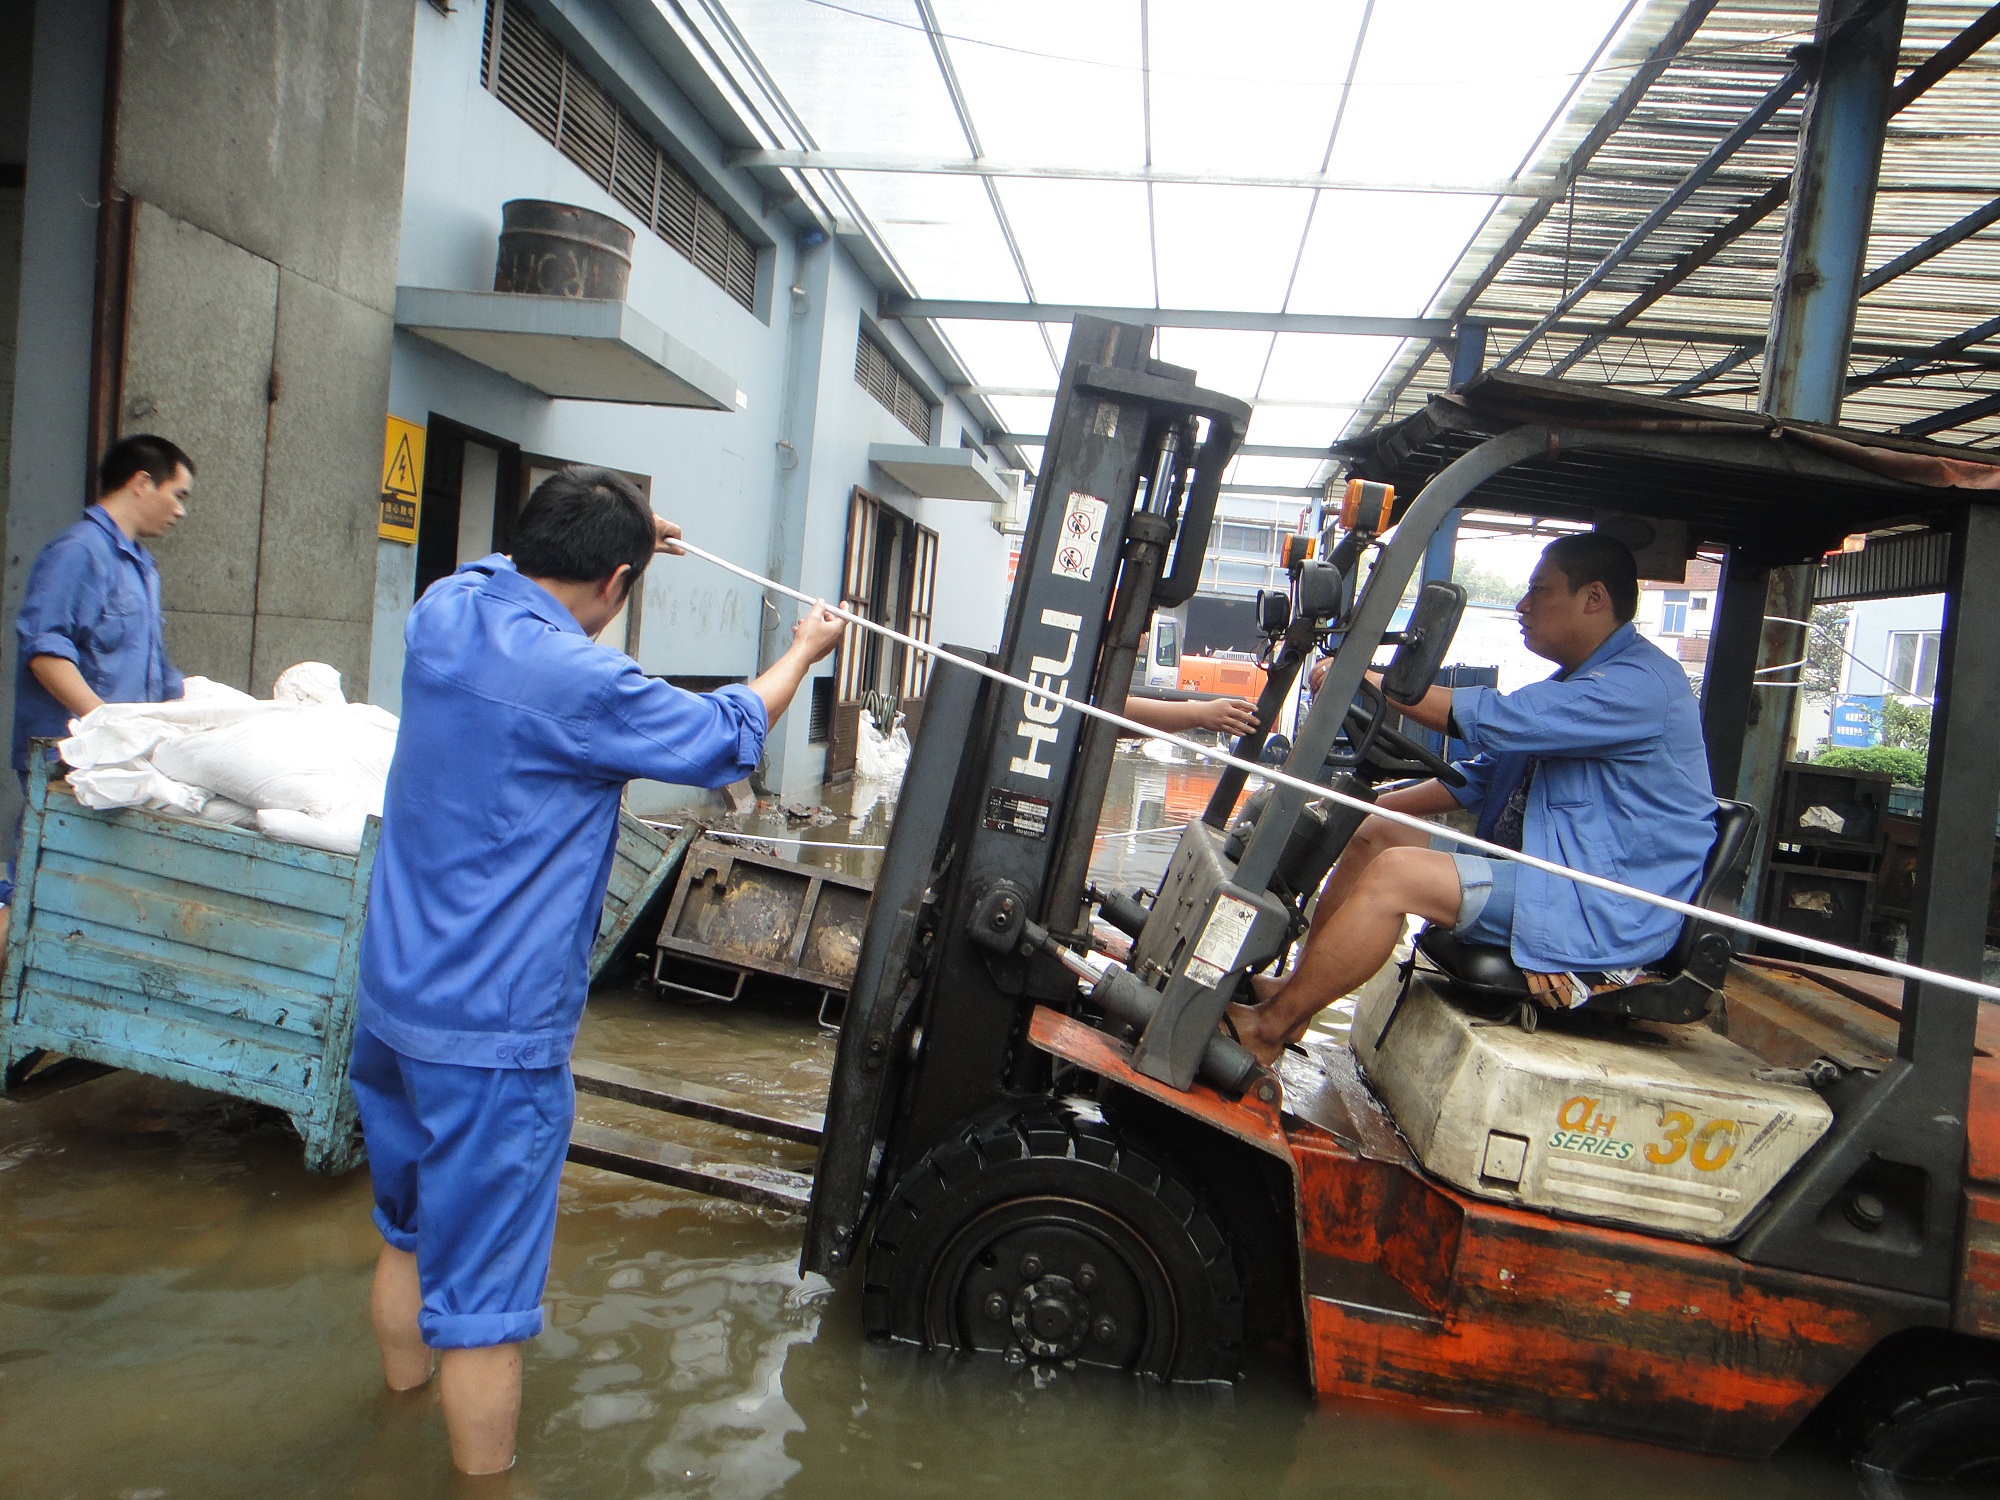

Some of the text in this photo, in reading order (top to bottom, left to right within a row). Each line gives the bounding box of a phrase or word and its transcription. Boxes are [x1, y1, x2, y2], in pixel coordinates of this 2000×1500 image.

[1009, 608, 1083, 780] HELI
[1548, 1131, 1635, 1160] SERIES
[1643, 1110, 1741, 1172] 30
